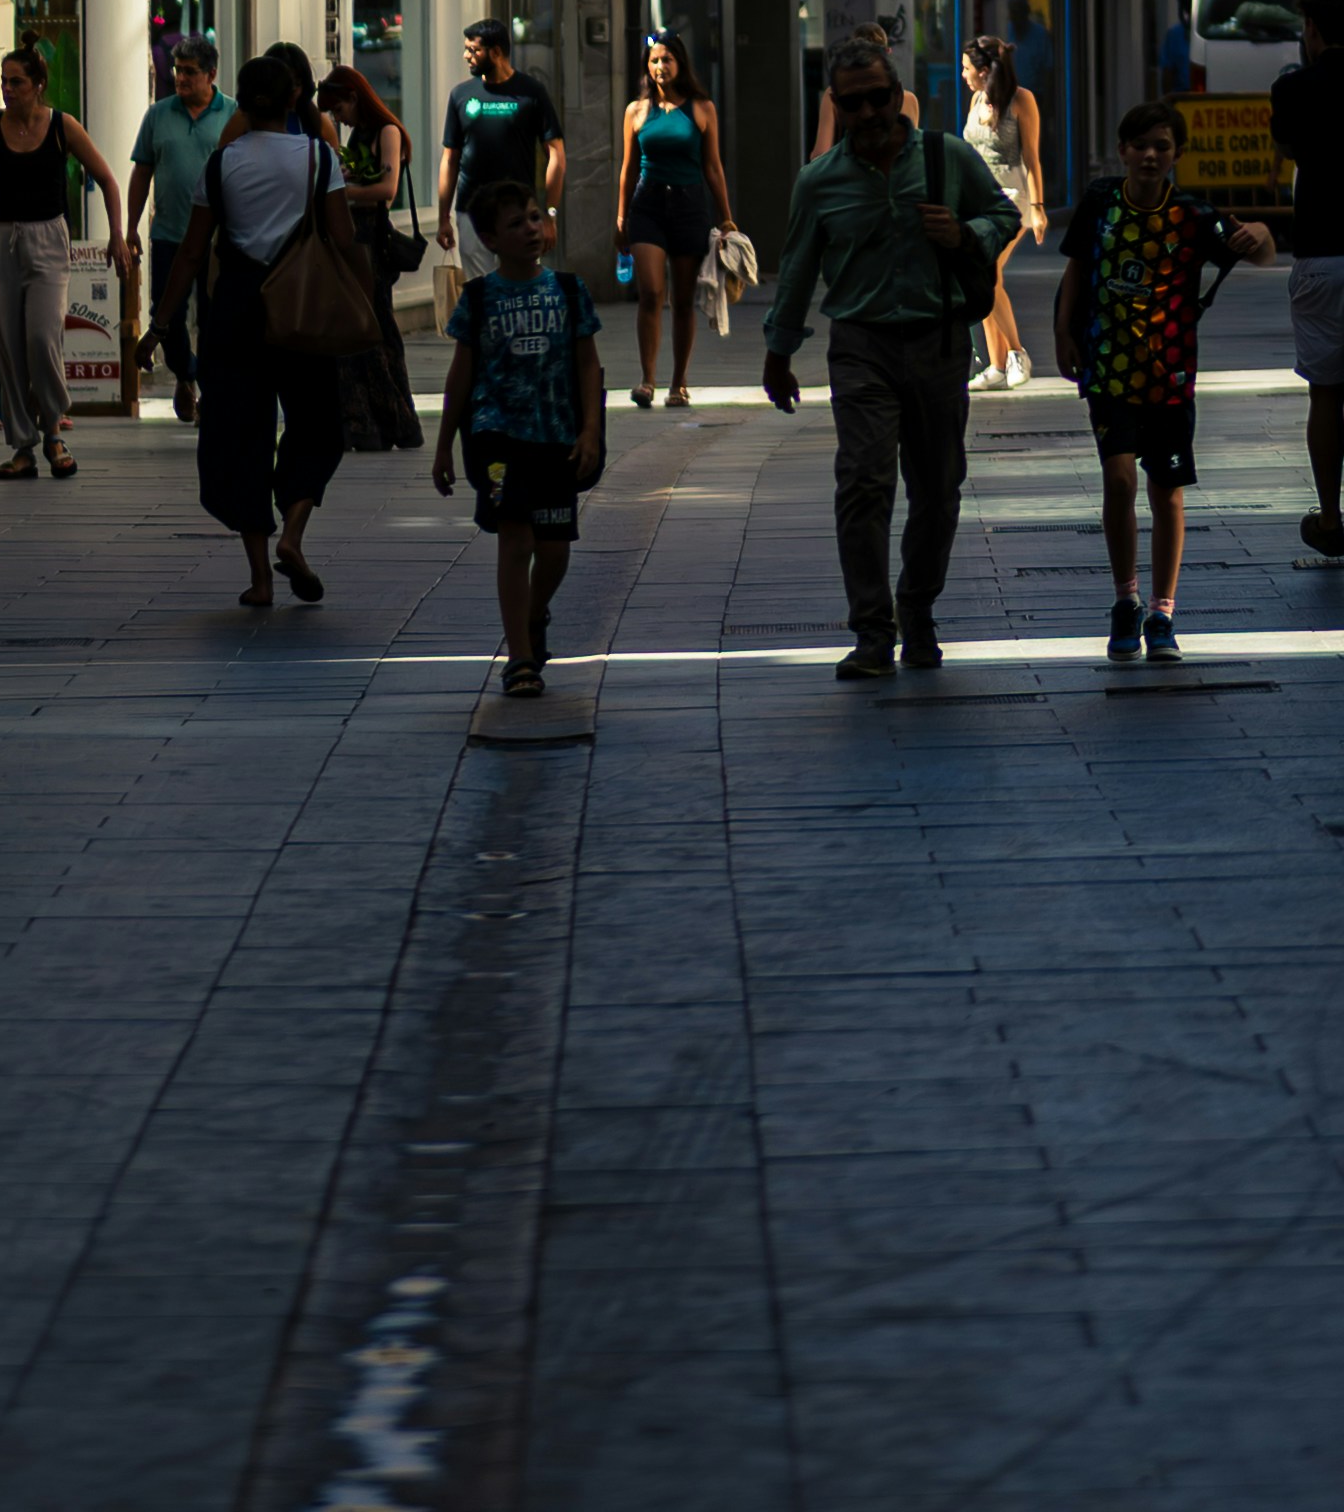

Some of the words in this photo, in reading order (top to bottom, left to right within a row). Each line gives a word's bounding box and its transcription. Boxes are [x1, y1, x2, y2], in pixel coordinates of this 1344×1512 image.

[1192, 107, 1271, 129] ATENCIO
[1183, 135, 1224, 152] ALLE
[1229, 134, 1275, 152] CORT
[1198, 160, 1226, 176] POR
[1231, 158, 1275, 177] OBRA
[496, 296, 524, 312] THIS
[528, 294, 540, 307] IS
[544, 295, 560, 307] MY
[487, 308, 568, 340] FUNDAY
[65, 364, 113, 377] ERTO
